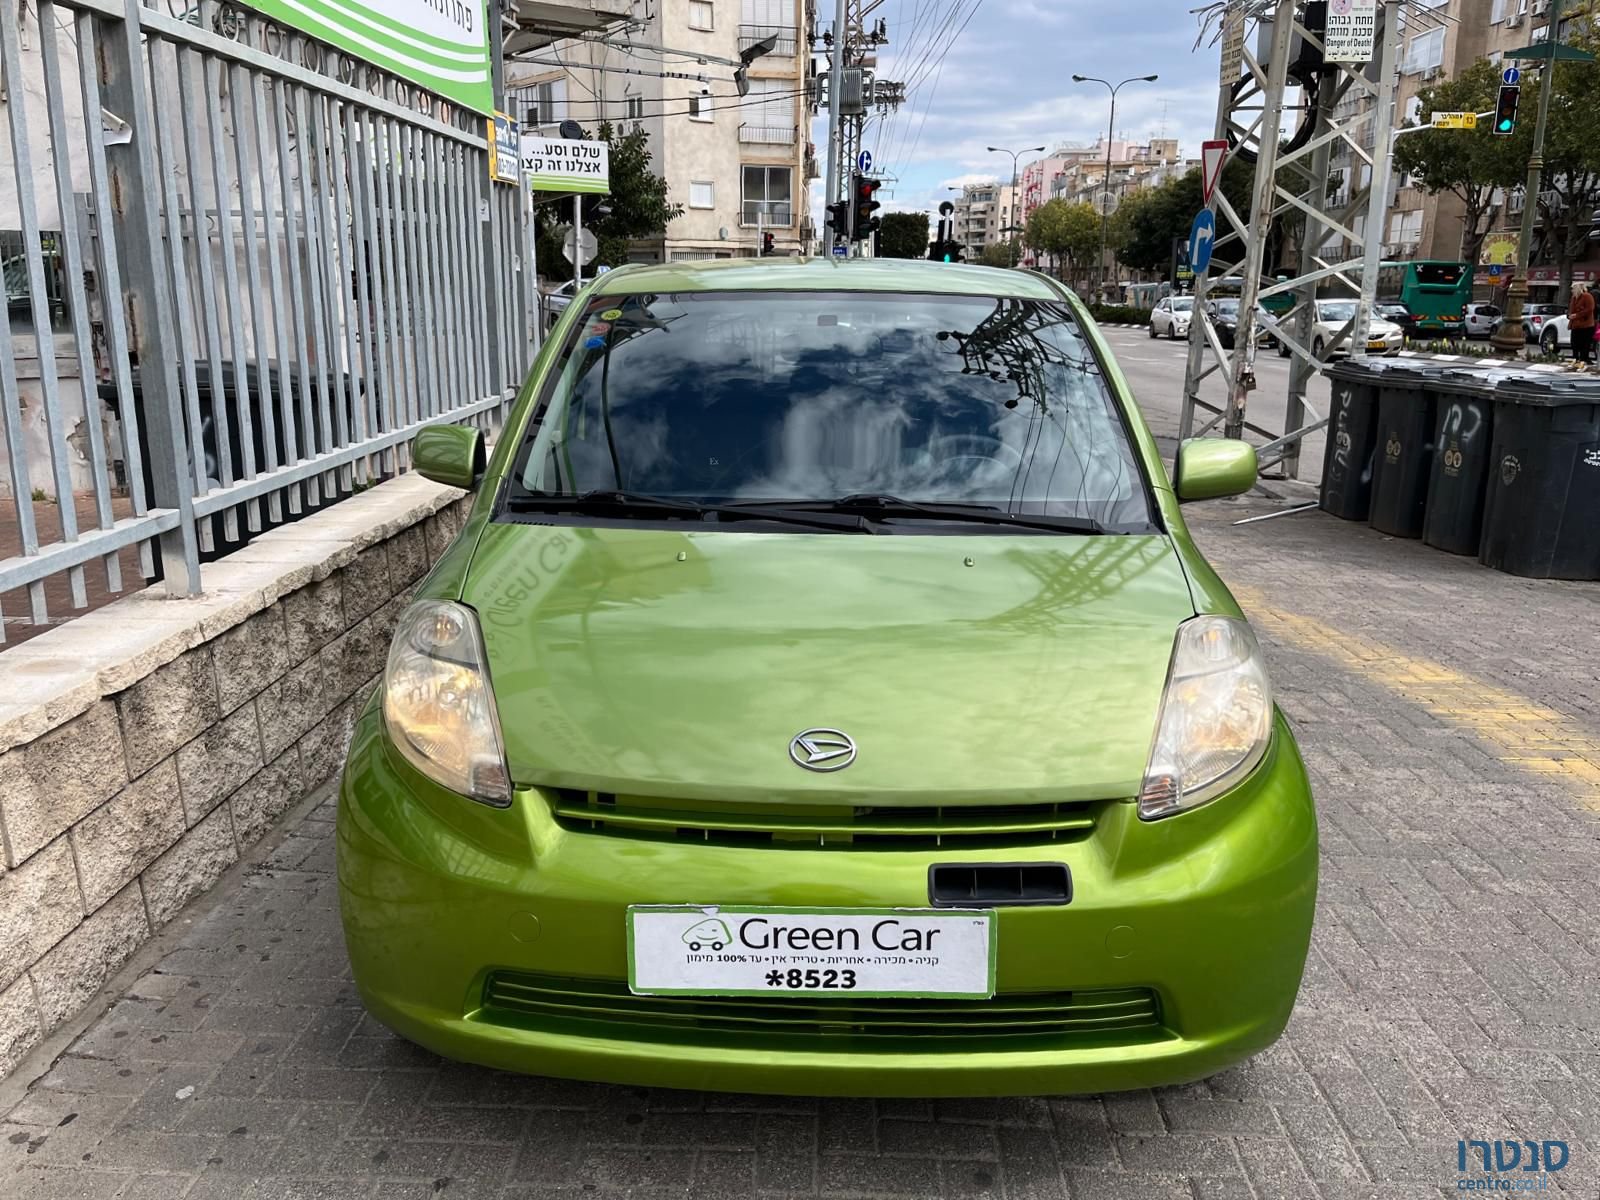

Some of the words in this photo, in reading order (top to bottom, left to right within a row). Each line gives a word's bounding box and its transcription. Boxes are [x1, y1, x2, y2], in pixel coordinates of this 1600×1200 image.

[424, 0, 473, 33] פתרונ
[1328, 16, 1352, 25] גבוה!
[1355, 16, 1373, 25] מתח
[1327, 28, 1349, 37] מוות!
[1352, 28, 1373, 37] סכנת
[1326, 38, 1346, 48] Danger
[1347, 38, 1354, 47] of
[1354, 38, 1372, 47] Death!
[532, 144, 567, 156] וסע...
[572, 144, 600, 158] שלם
[547, 159, 562, 171] זה
[566, 159, 601, 173] אצלנו
[739, 918, 860, 951] Green
[871, 919, 941, 951] Car
[686, 954, 713, 964] מימון
[716, 954, 747, 963] 100%
[748, 955, 762, 963] עד
[772, 955, 786, 965] אין
[790, 955, 818, 964] טרייד
[827, 956, 864, 965] אחריות
[874, 956, 905, 965] מכירה
[915, 956, 939, 966] קניה
